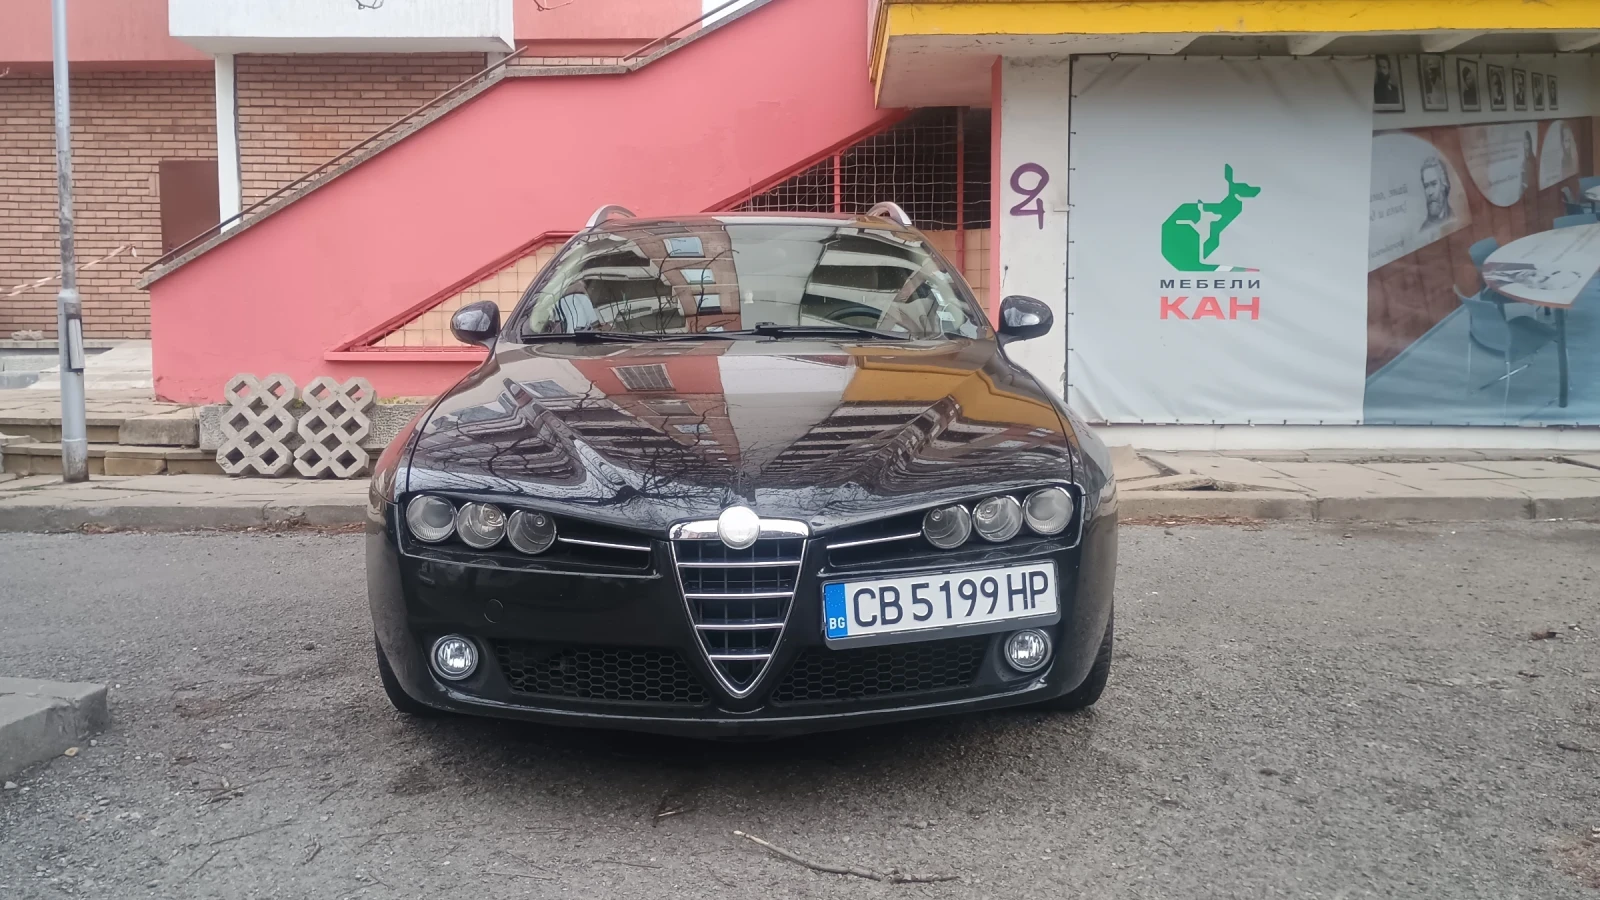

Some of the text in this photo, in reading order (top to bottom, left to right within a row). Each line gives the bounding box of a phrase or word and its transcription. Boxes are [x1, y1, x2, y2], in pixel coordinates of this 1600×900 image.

[1160, 279, 1260, 289] МЕБЕЛИ
[1160, 296, 1260, 320] КАН
[829, 616, 846, 630] BG
